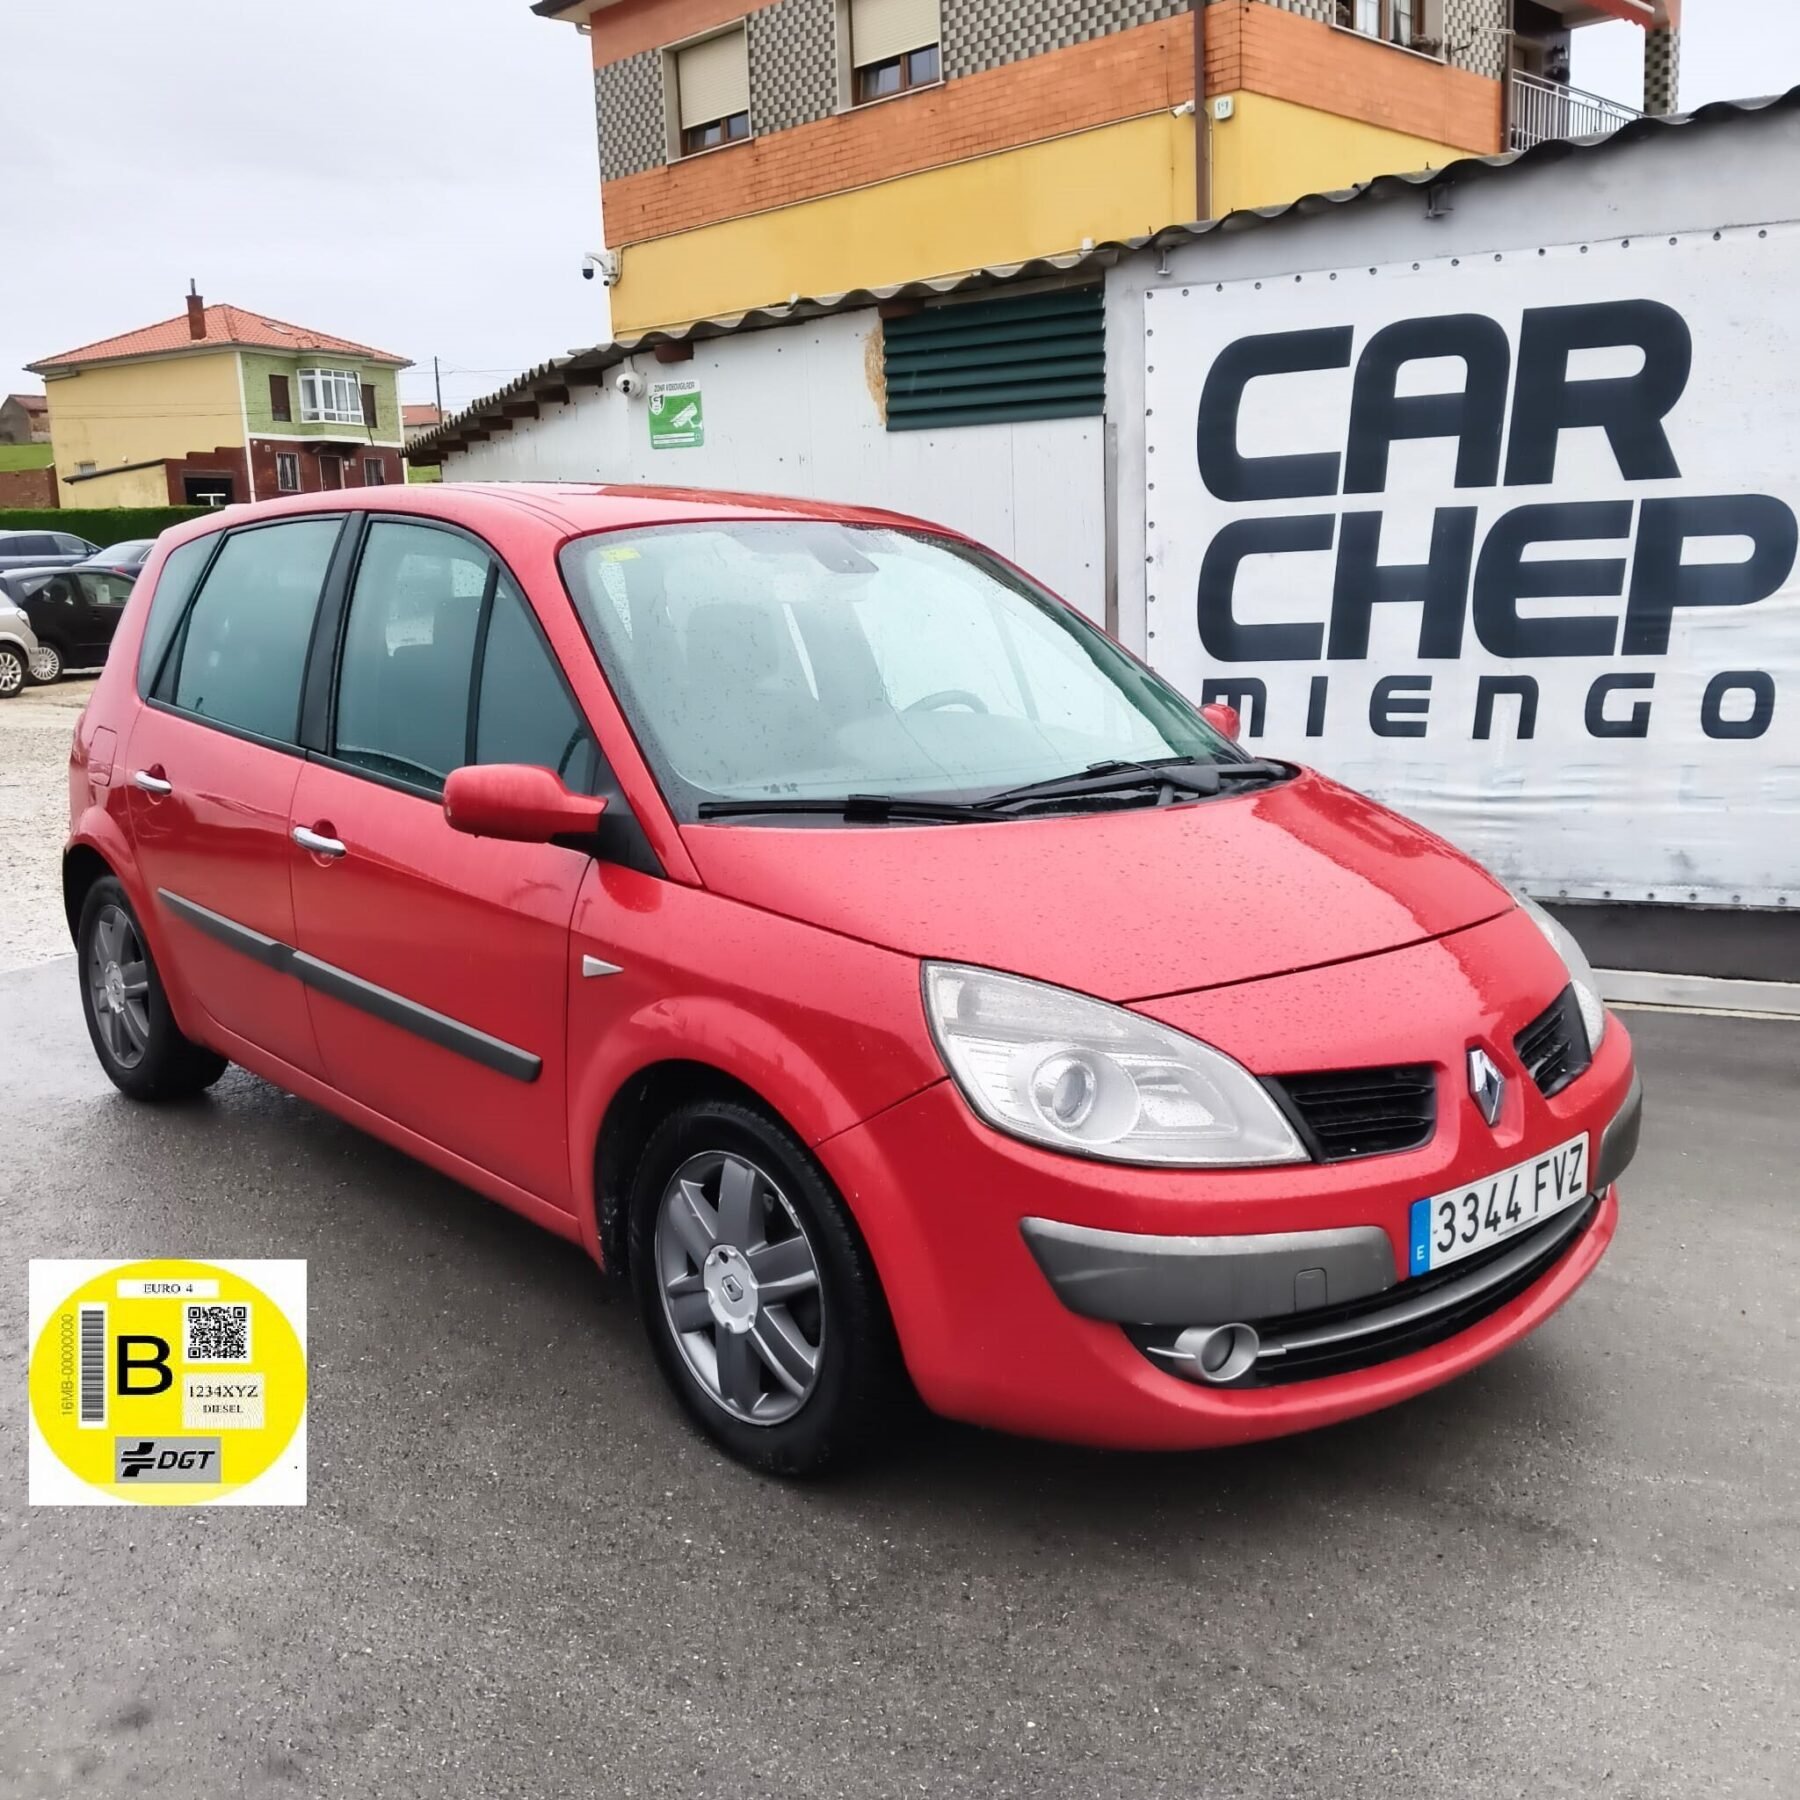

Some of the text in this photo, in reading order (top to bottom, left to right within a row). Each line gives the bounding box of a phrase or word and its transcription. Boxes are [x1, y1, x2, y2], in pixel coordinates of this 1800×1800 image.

[1197, 298, 1692, 502] CAR
[1197, 493, 1799, 662] CHEP
[1202, 670, 1775, 739] MIENGO
[1416, 1245, 1425, 1260] E
[1437, 1142, 1584, 1253] 3344 FVZ
